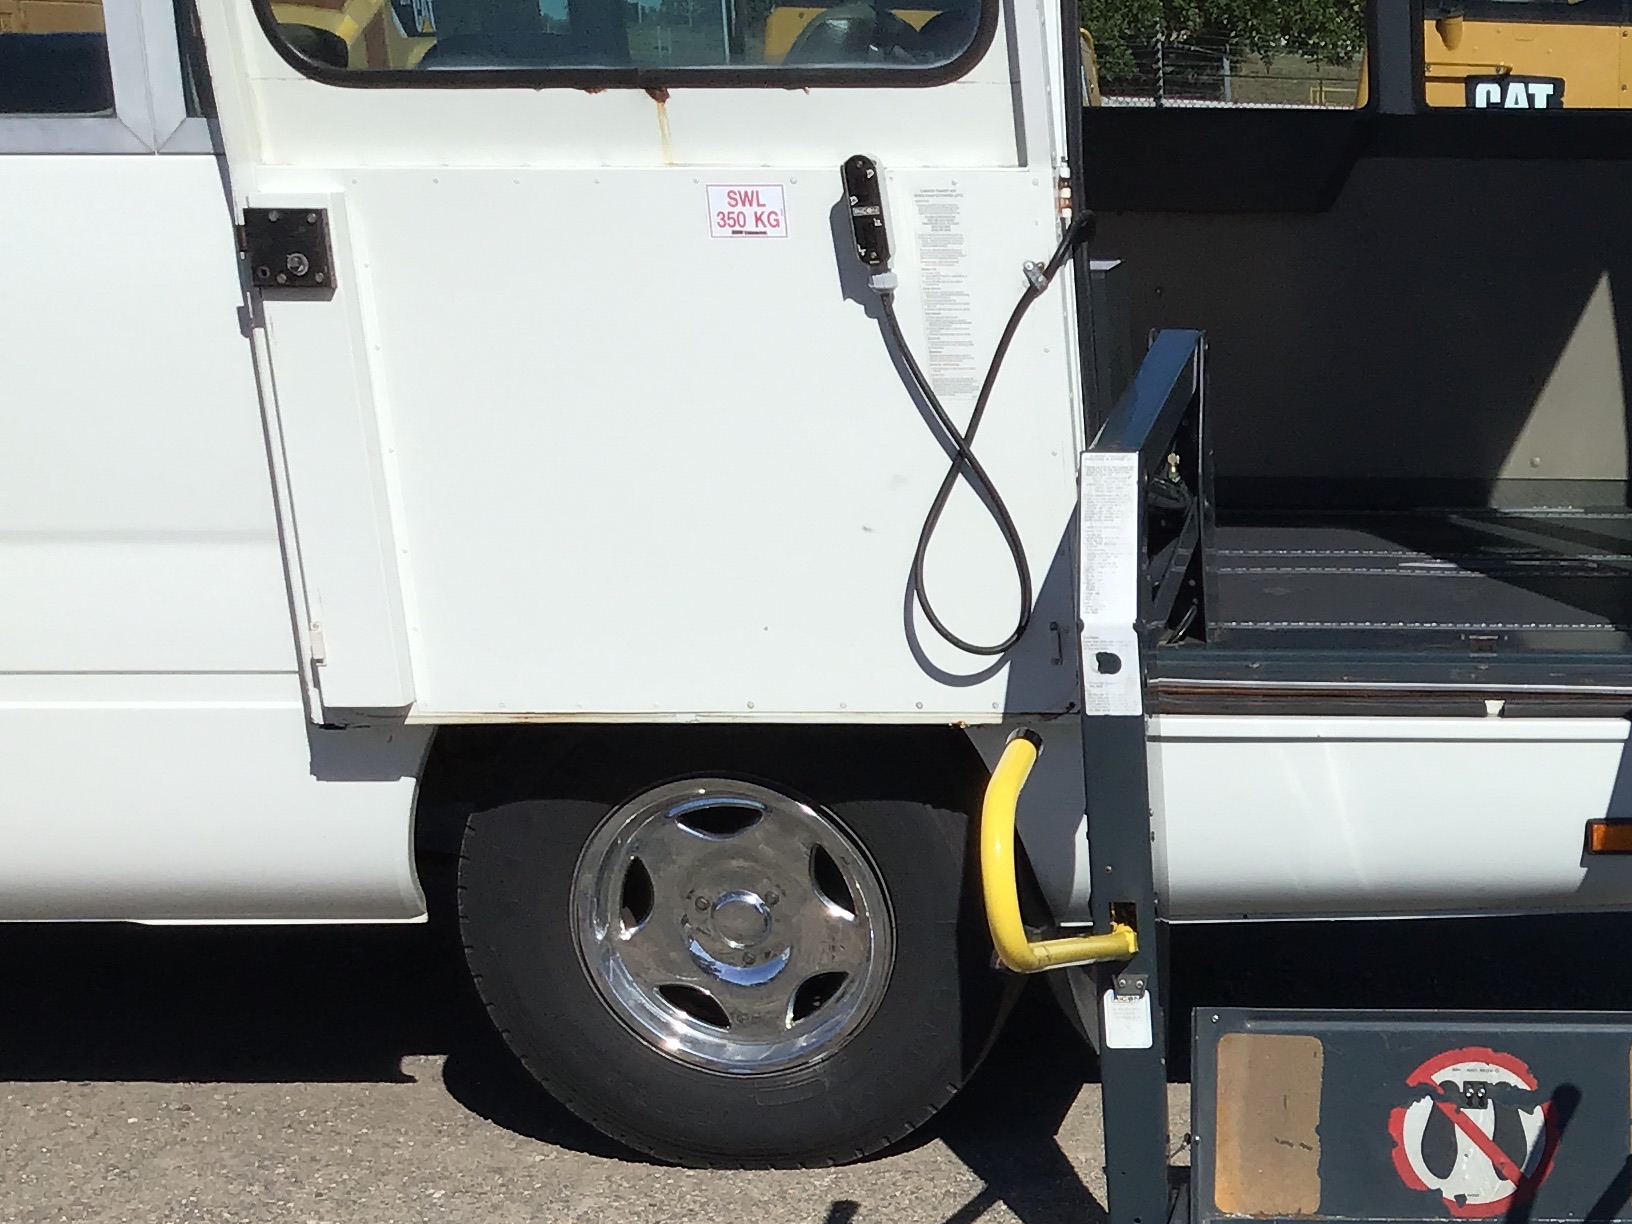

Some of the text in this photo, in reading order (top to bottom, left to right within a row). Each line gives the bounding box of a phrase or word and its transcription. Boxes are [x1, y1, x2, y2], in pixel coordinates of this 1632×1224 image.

[1475, 82, 1554, 108] CAT
[727, 189, 767, 208] SWL
[716, 210, 781, 229] 350 KG
